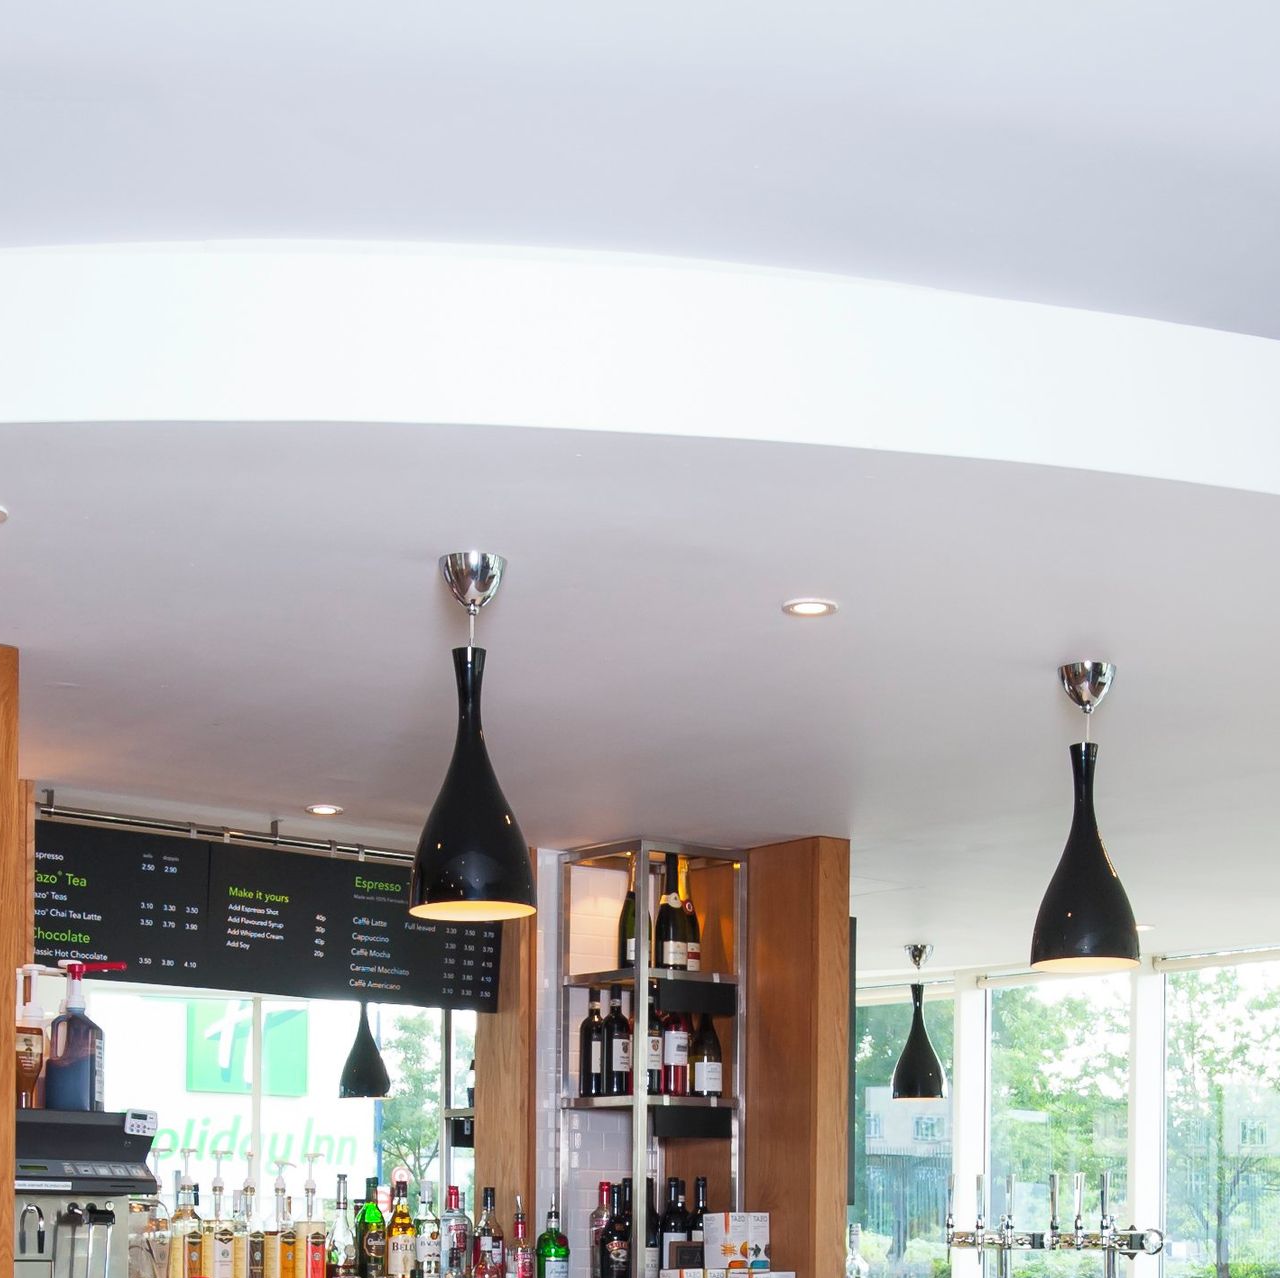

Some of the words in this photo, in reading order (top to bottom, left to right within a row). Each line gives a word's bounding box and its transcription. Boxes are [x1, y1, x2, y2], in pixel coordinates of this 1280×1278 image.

[35, 851, 64, 861] spresso
[65, 872, 87, 887] Tea
[355, 876, 402, 893] Espresso
[50, 891, 67, 901] Teas
[228, 886, 254, 899] Make
[255, 890, 263, 900] it
[264, 893, 289, 903] yours
[228, 903, 241, 912] Add
[49, 908, 67, 917] Chai
[68, 910, 81, 919] Tea
[82, 912, 102, 921] Latte
[227, 915, 240, 924] Add
[226, 927, 240, 936] Add
[239, 930, 266, 939] Whipped
[226, 940, 239, 948] Add
[239, 942, 251, 950] Soy
[34, 947, 54, 956] lassic
[54, 949, 69, 958] Hot
[70, 950, 108, 961] Chocolate
[369, 949, 391, 959] Mocha
[377, 966, 410, 977] Macchiato
[148, 1114, 294, 1178] oliday
[298, 1116, 358, 1166] Inn
